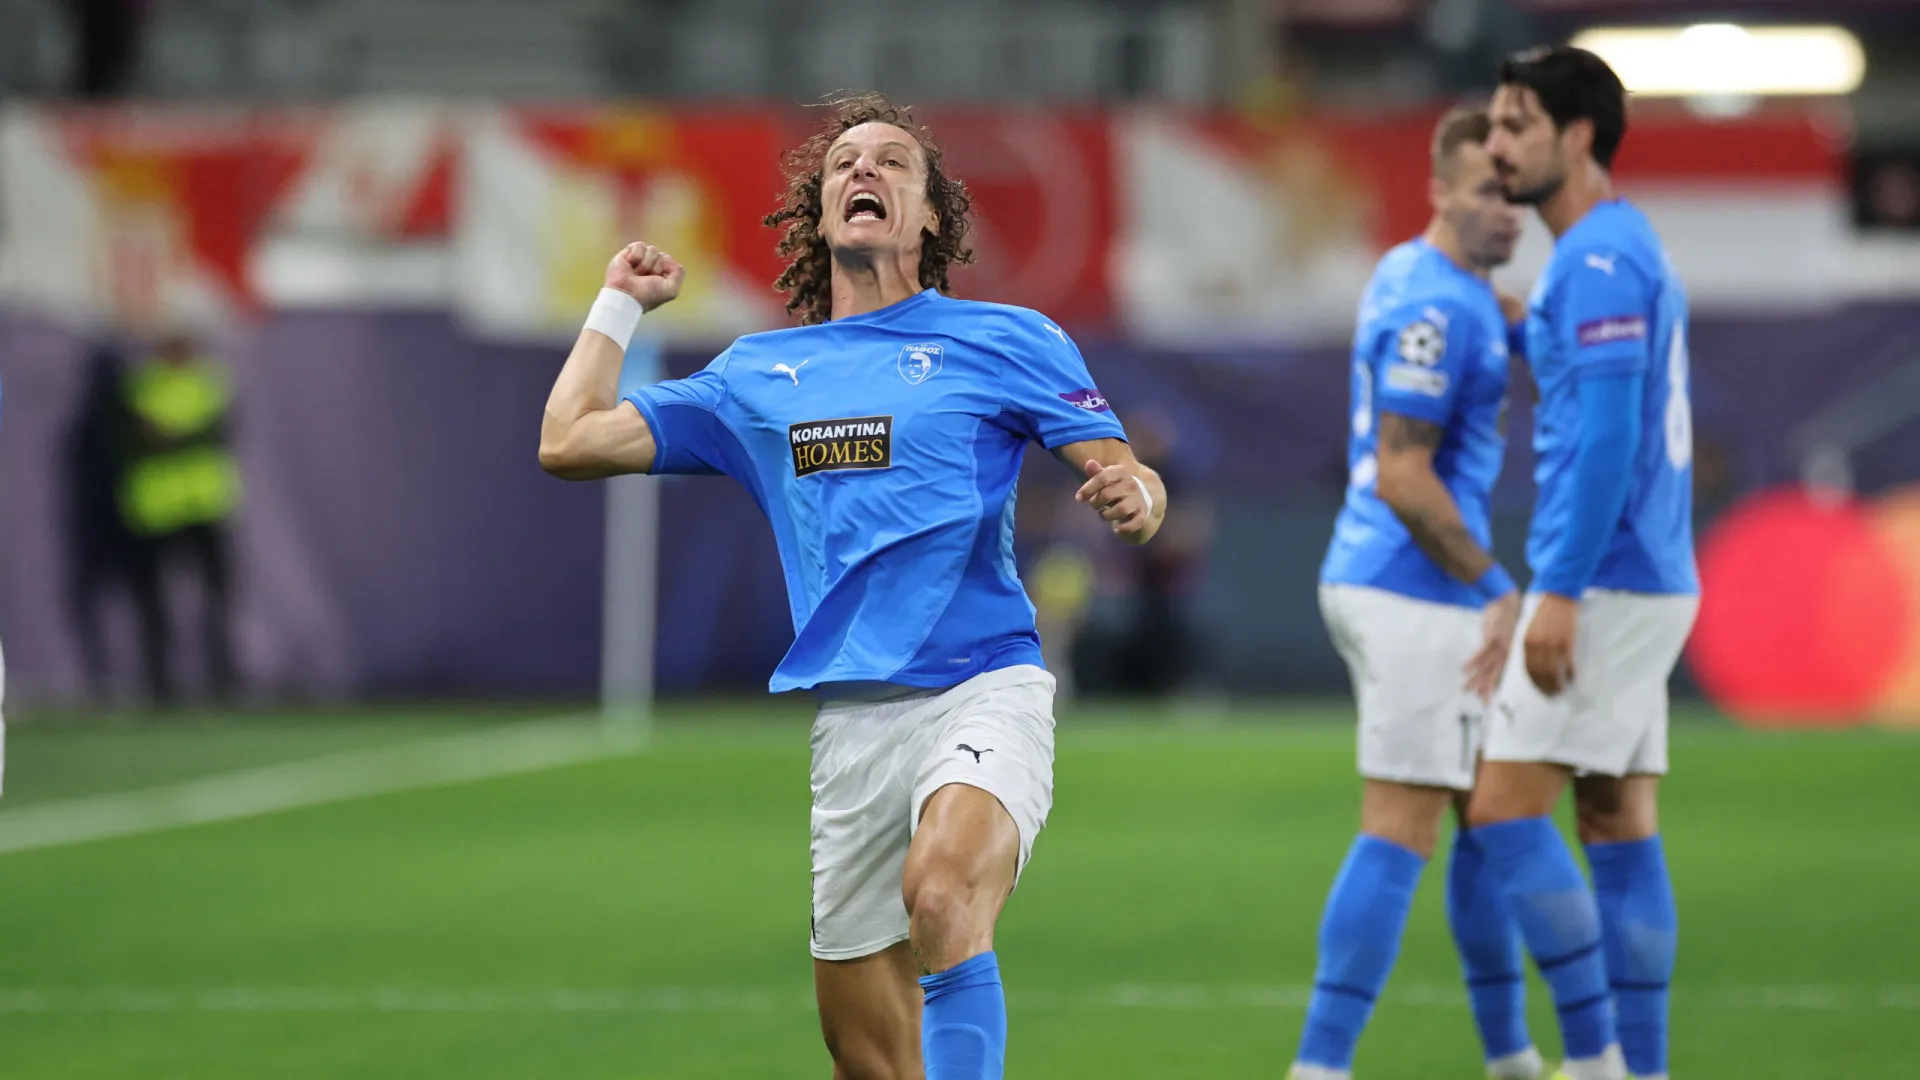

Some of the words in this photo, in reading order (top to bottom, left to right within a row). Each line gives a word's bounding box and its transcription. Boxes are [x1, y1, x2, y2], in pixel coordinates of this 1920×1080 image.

[905, 345, 940, 355] ΠΑΦΟΣ
[791, 422, 886, 444] KORANTINA
[795, 439, 884, 470] HOMES
